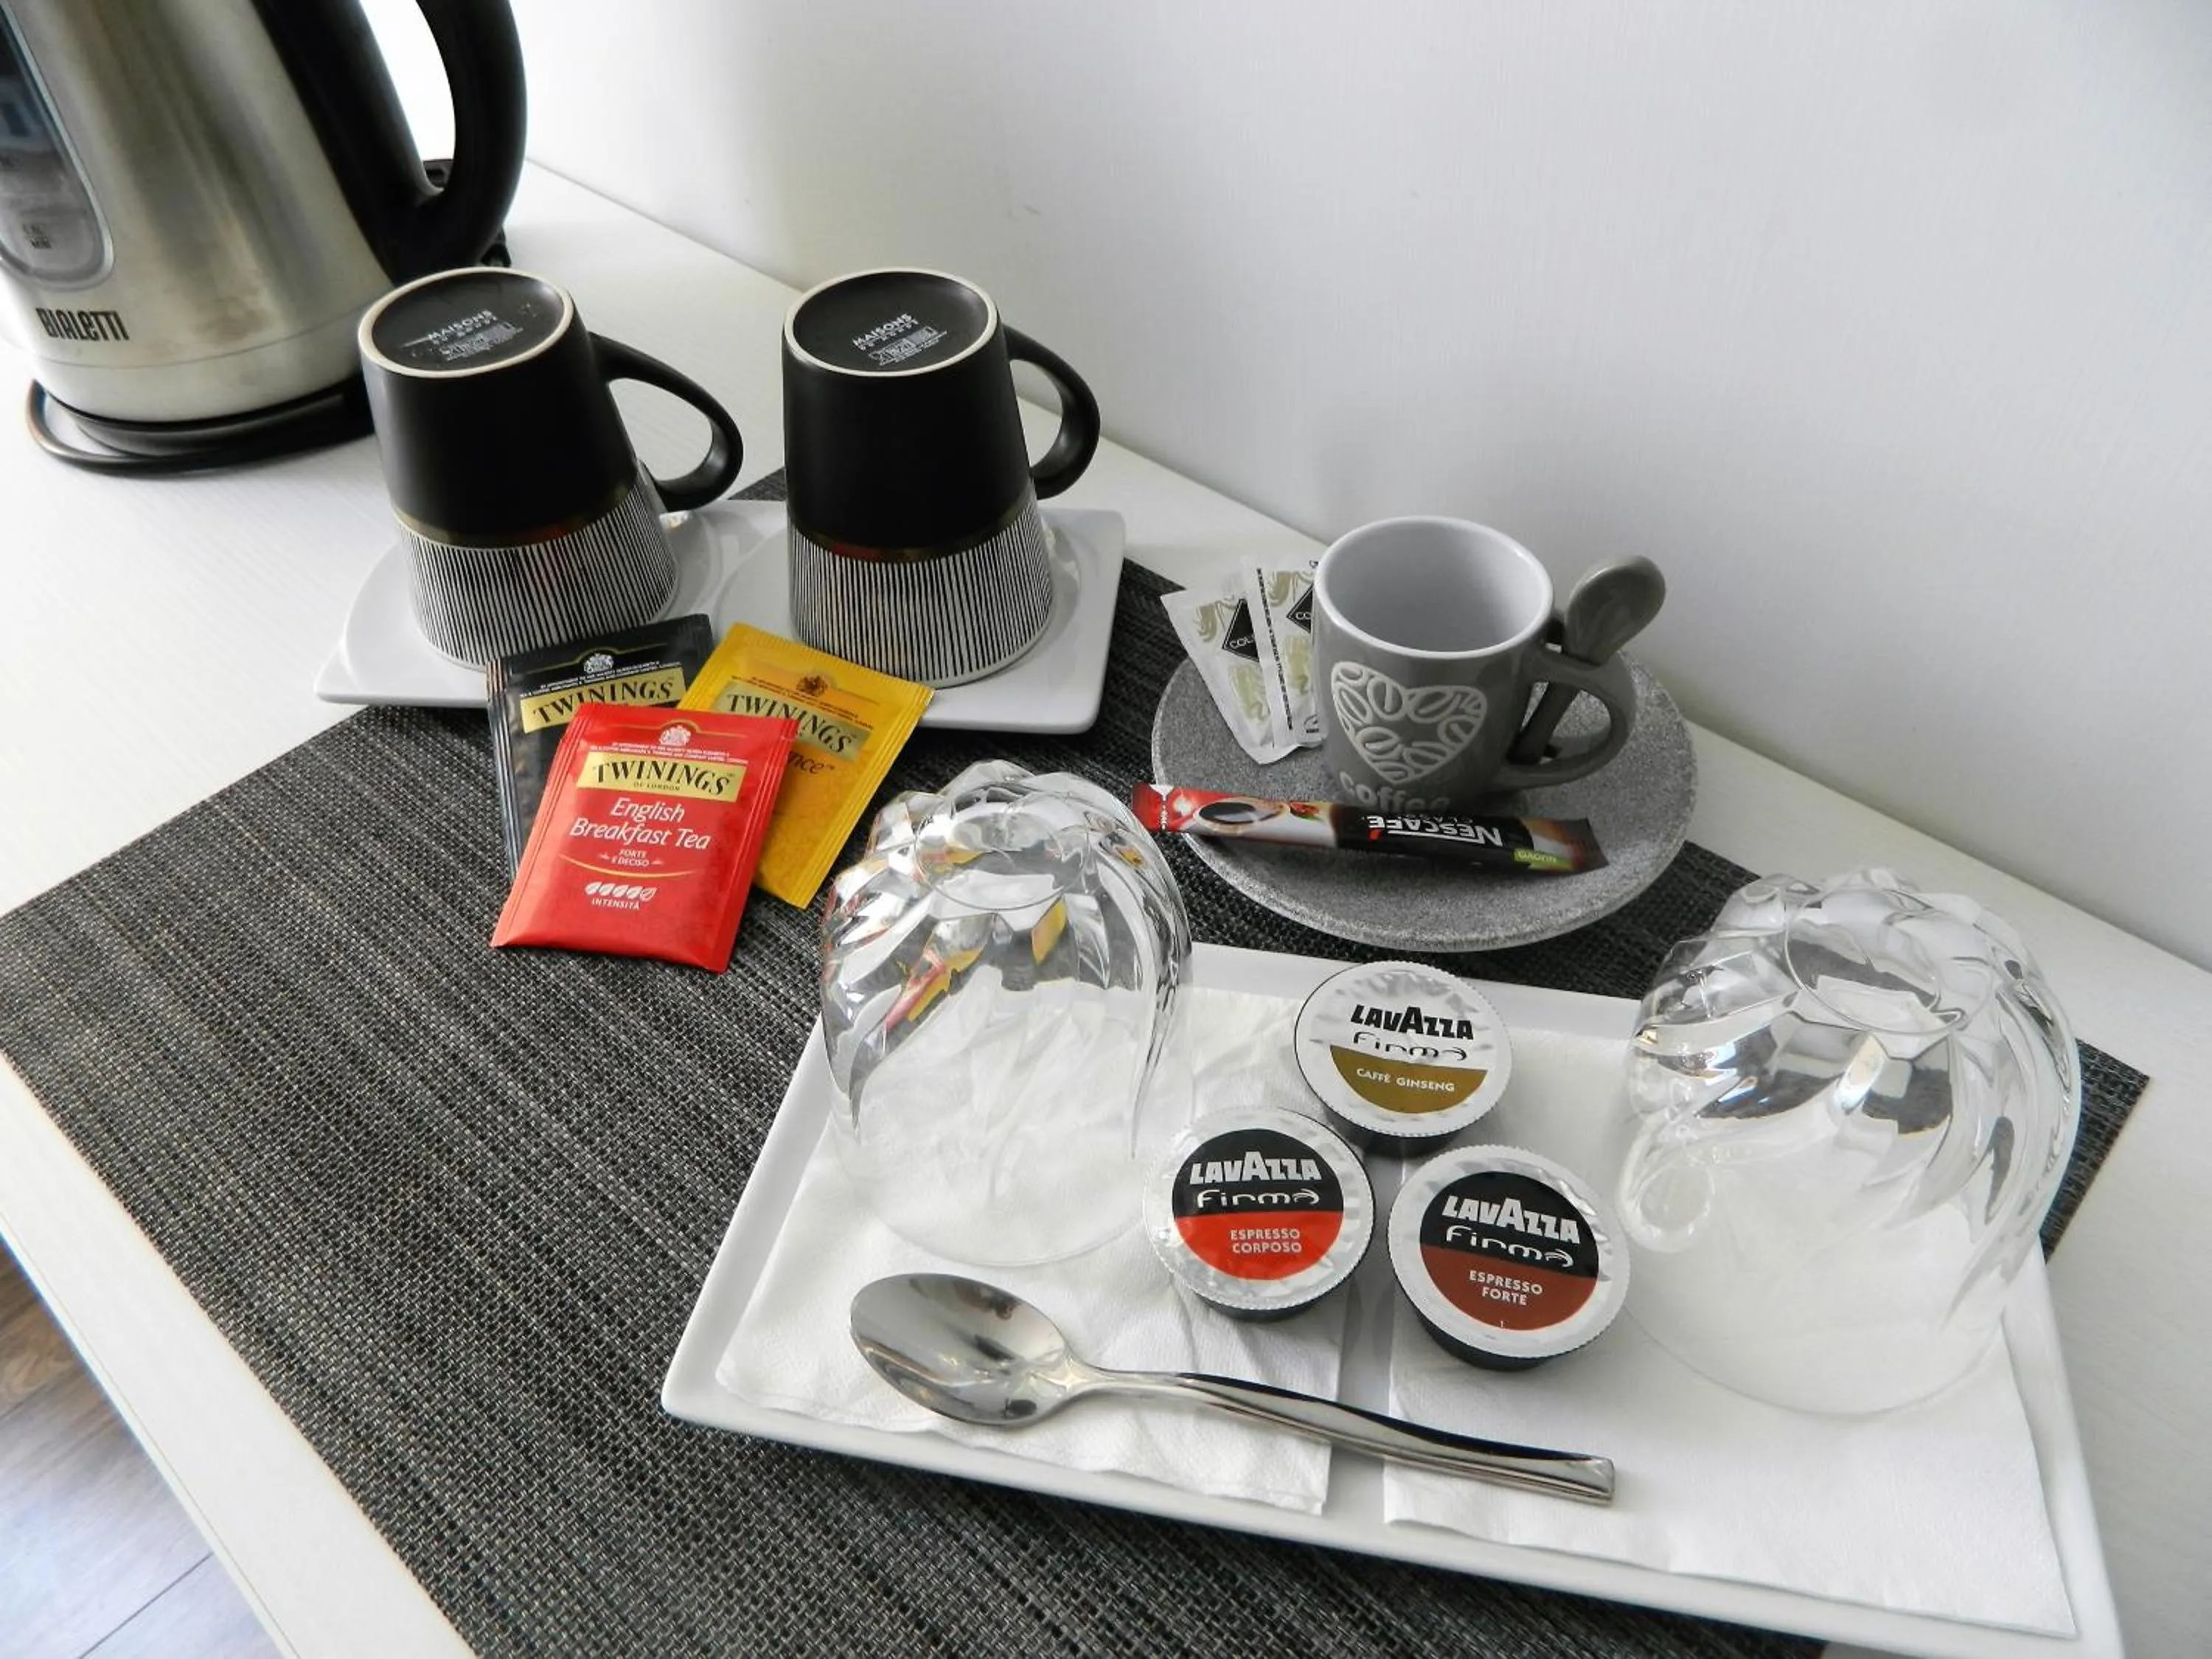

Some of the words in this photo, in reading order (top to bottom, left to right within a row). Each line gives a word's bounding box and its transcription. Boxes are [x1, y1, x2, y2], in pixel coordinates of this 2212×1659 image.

[35, 307, 129, 341] BIALETTI
[1295, 611, 1312, 620] CO
[532, 680, 673, 723] TWININGS
[727, 695, 852, 753] TWININGS
[593, 760, 729, 796] TWININGS
[647, 783, 681, 791] LONDON
[611, 797, 685, 823] English
[569, 817, 672, 846] Breakfast
[675, 828, 712, 849] Tea
[618, 856, 650, 867] DECISO
[619, 849, 647, 858] FORTE
[1351, 1004, 1474, 1040] LAVAZZA
[1396, 1077, 1455, 1092] GINSENG
[1189, 1151, 1322, 1185] LAVAZZA
[1441, 1194, 1581, 1245] LAVAZZA
[1229, 1228, 1301, 1241] ESPRESSO
[1232, 1242, 1302, 1254] CORPOSO
[1469, 1270, 1543, 1295] ESPRESSO
[1481, 1286, 1528, 1307] FORTE
